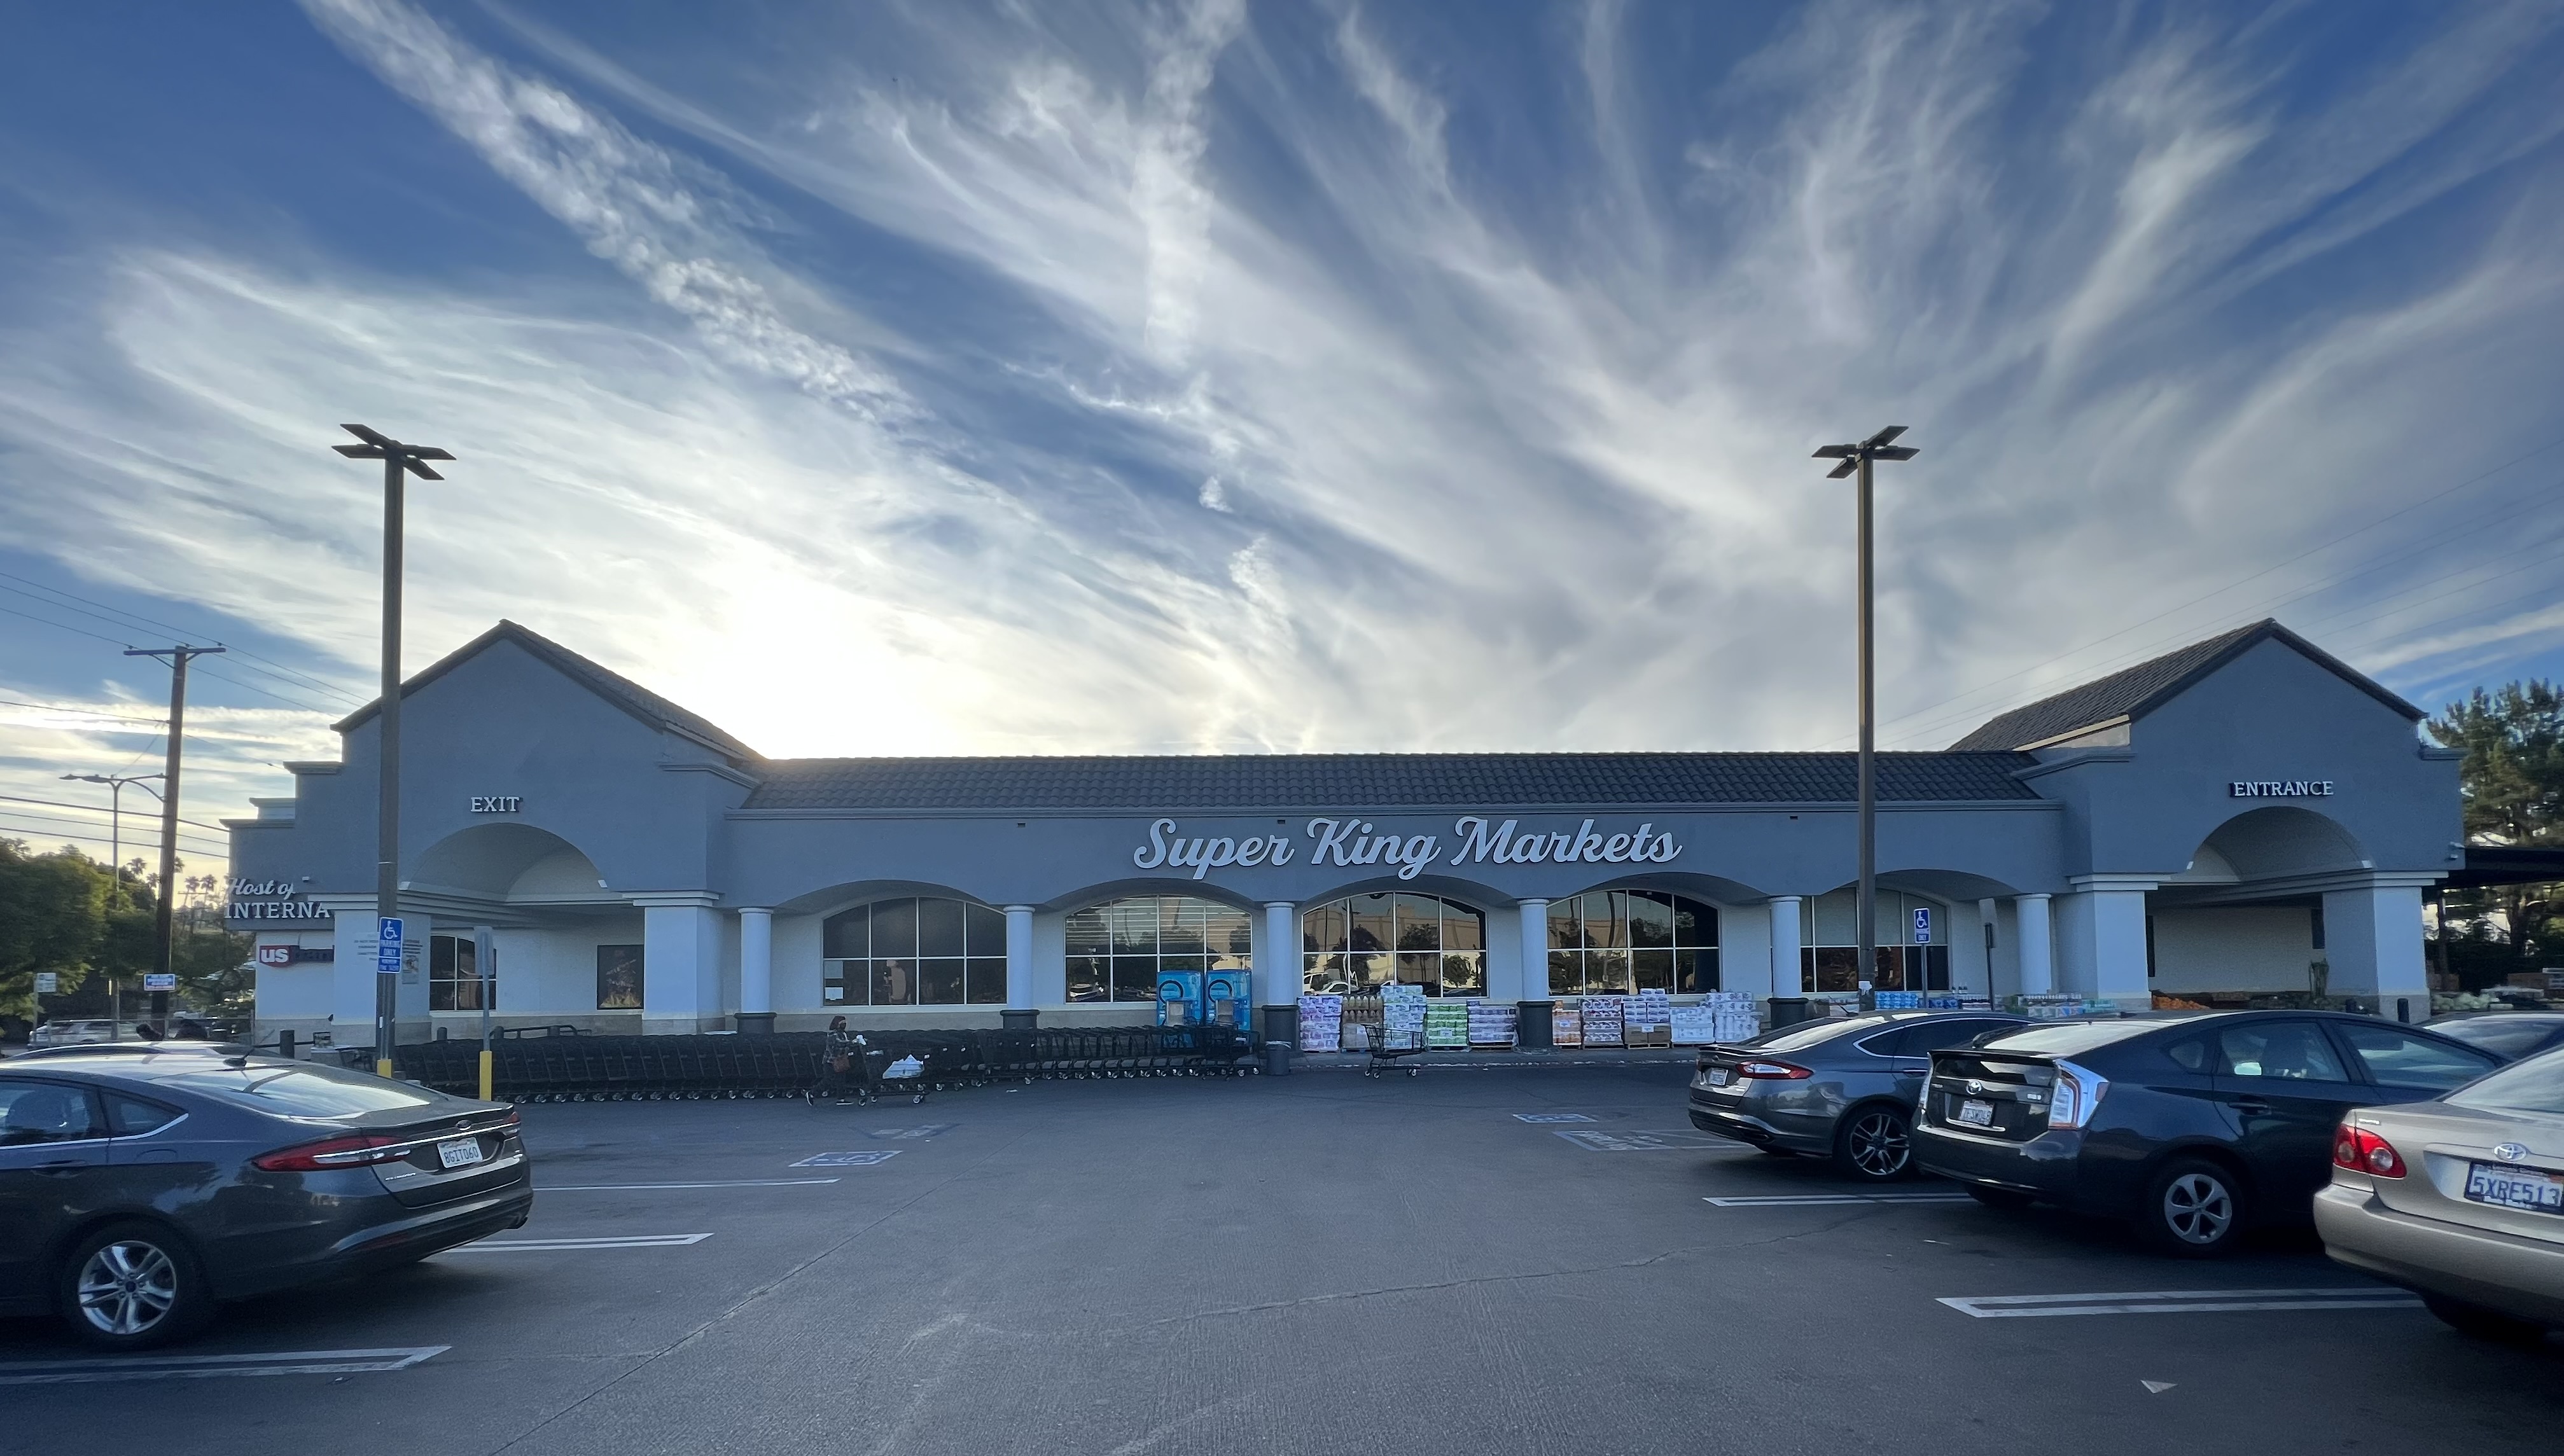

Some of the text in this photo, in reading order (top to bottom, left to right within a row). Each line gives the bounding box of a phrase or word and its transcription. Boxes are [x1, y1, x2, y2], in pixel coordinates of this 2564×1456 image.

[2234, 781, 2334, 796] ENTRANCE
[470, 796, 520, 812] EXIT
[1134, 816, 1682, 880] Super King Markets
[228, 878, 275, 895] Host
[224, 902, 330, 919] INTERNA
[443, 1146, 478, 1163] 8GIT060
[2473, 1176, 2560, 1205] 5XRE513
